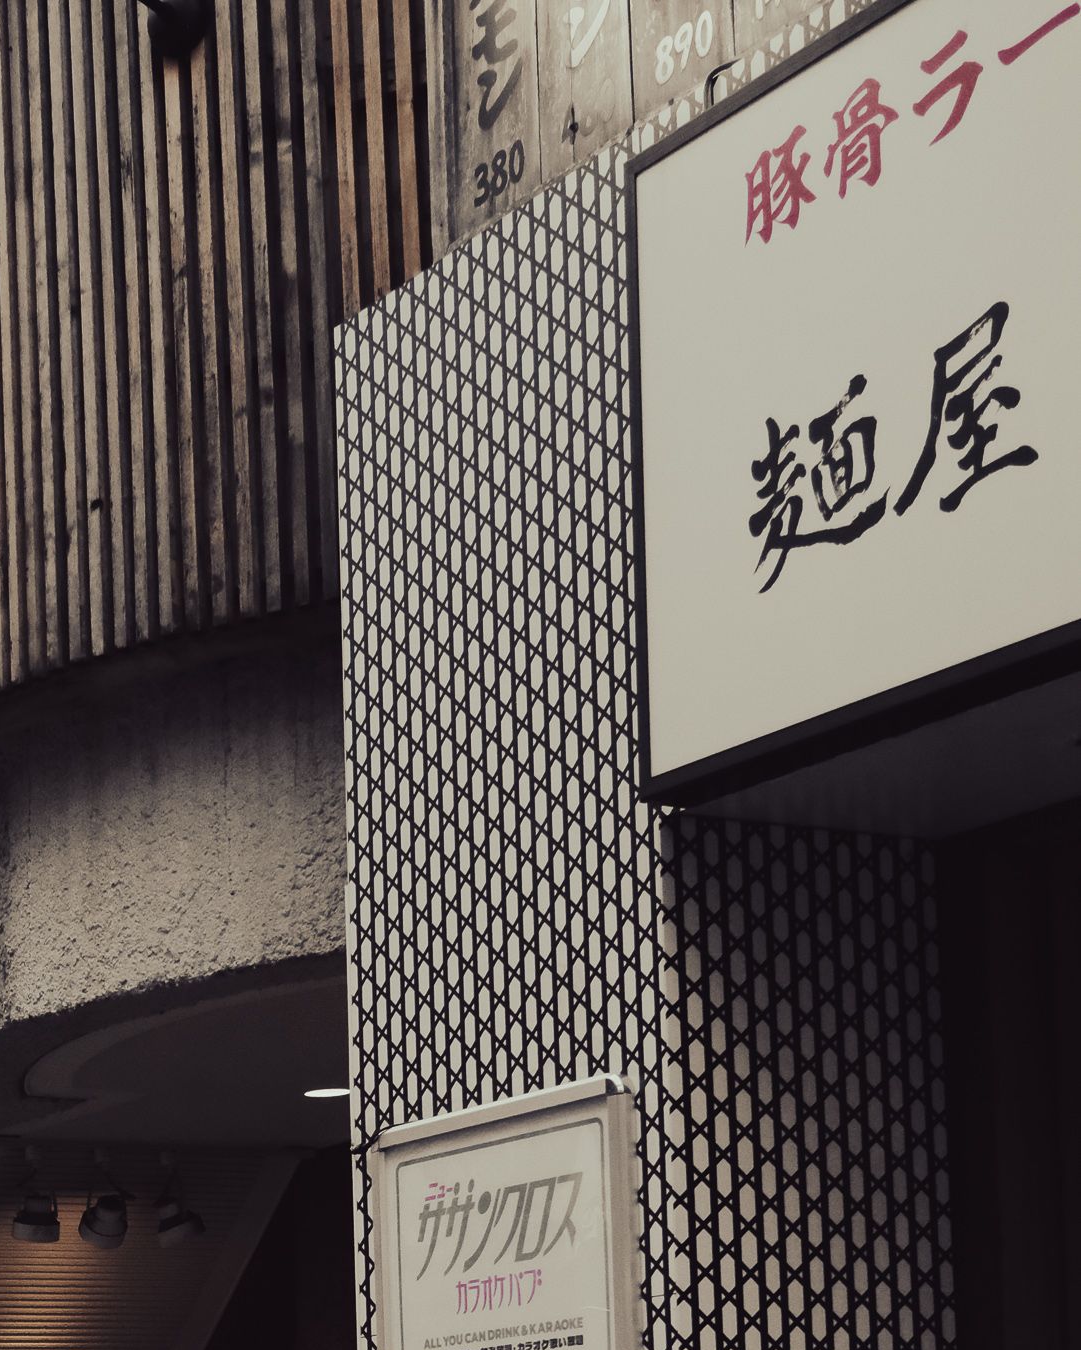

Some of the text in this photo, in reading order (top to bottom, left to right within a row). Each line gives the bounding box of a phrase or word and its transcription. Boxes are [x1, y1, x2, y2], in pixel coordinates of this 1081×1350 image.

[655, 10, 714, 85] 890
[744, 2, 1081, 247] 豚骨ラー
[474, 139, 525, 208] 380
[749, 301, 1039, 594] 麺屋
[424, 1338, 442, 1350] ALL
[443, 1334, 464, 1347] YOU
[465, 1330, 487, 1344] CAN
